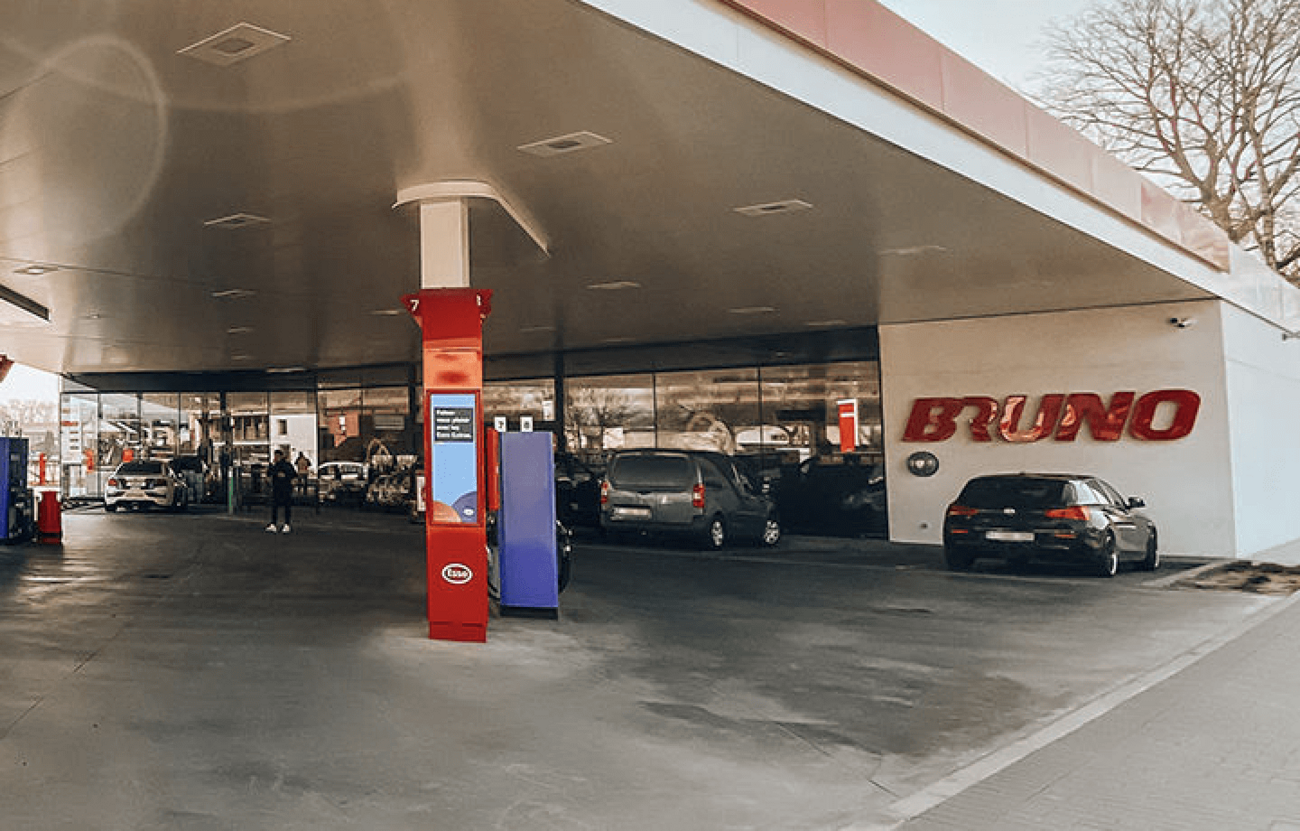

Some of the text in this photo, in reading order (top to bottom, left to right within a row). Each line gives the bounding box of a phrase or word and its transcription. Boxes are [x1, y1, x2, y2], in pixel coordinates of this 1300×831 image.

[410, 299, 420, 312] 7
[900, 389, 1202, 443] BRUNO
[447, 567, 469, 579] Esso
